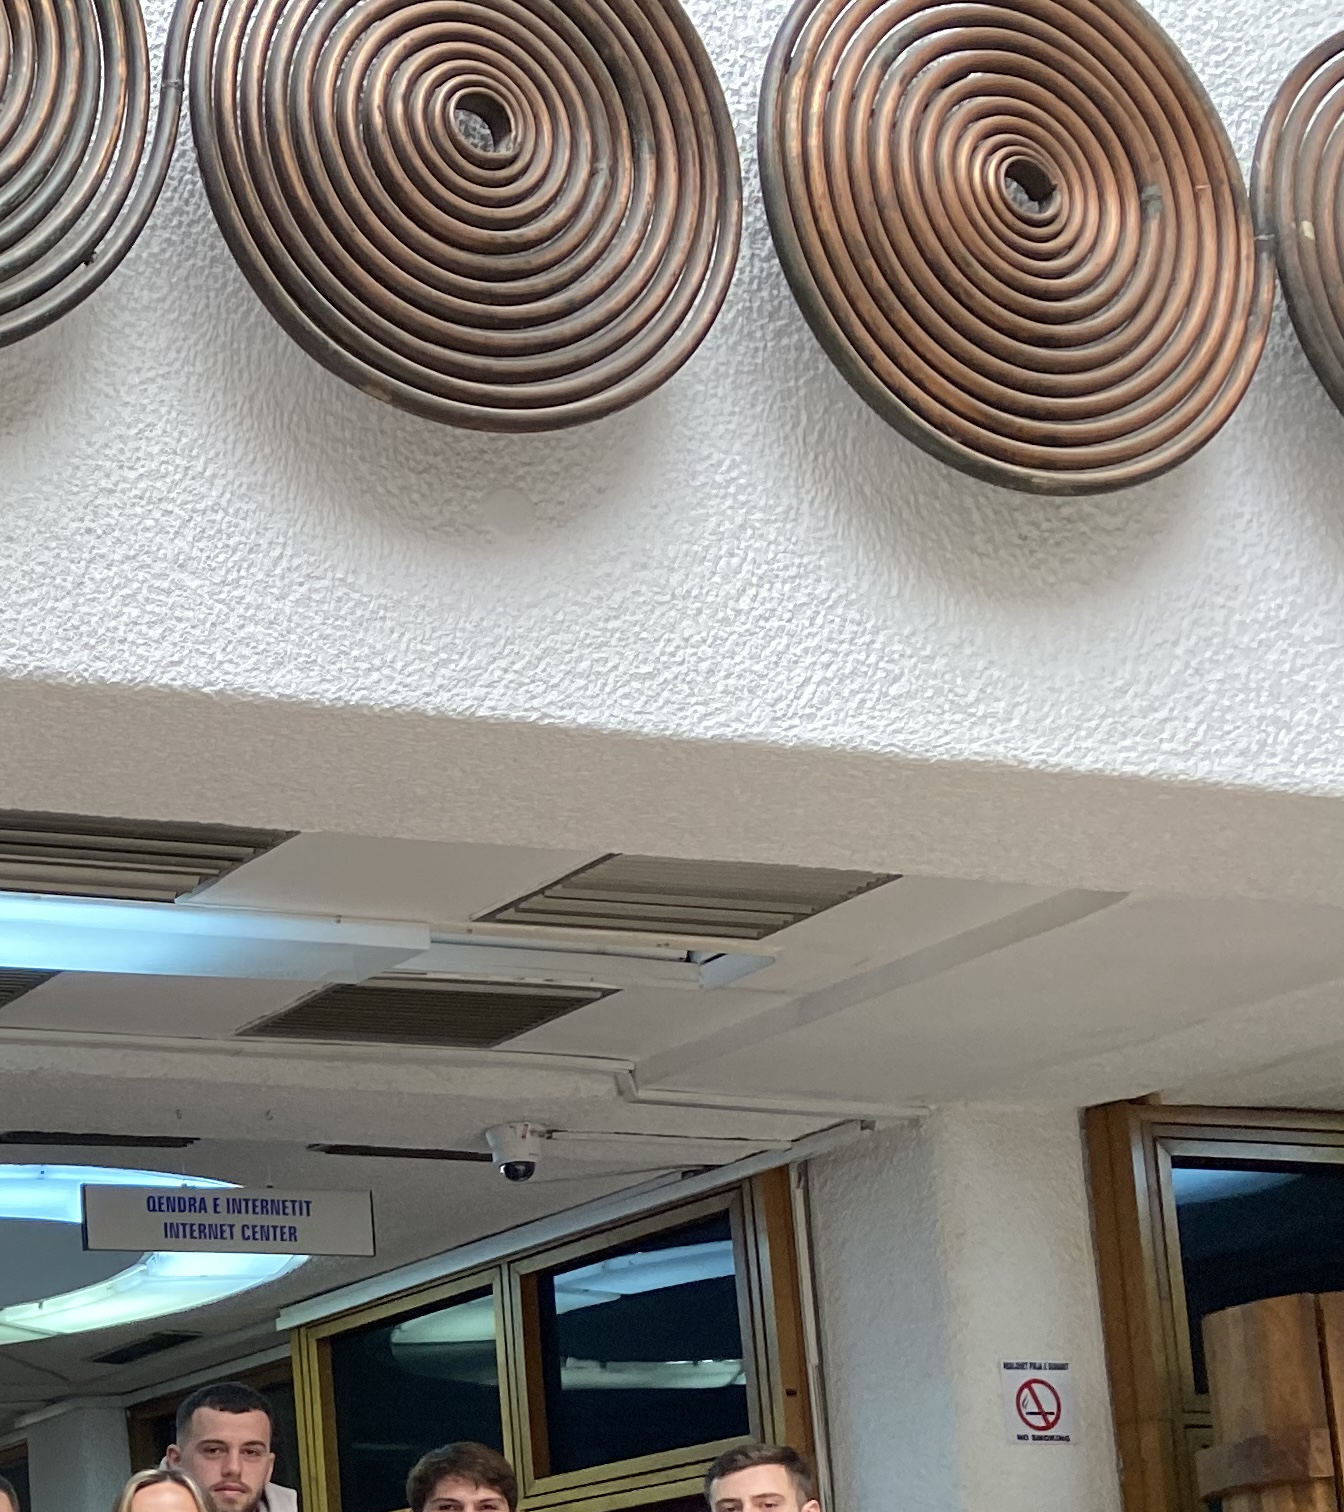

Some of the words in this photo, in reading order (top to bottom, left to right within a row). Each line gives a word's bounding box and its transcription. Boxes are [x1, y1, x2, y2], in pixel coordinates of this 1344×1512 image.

[146, 1196, 208, 1214] QENDRA
[213, 1198, 221, 1214] E
[226, 1198, 312, 1217] INTERNETIT
[163, 1222, 236, 1241] INTERNET
[241, 1224, 298, 1242] CENTER
